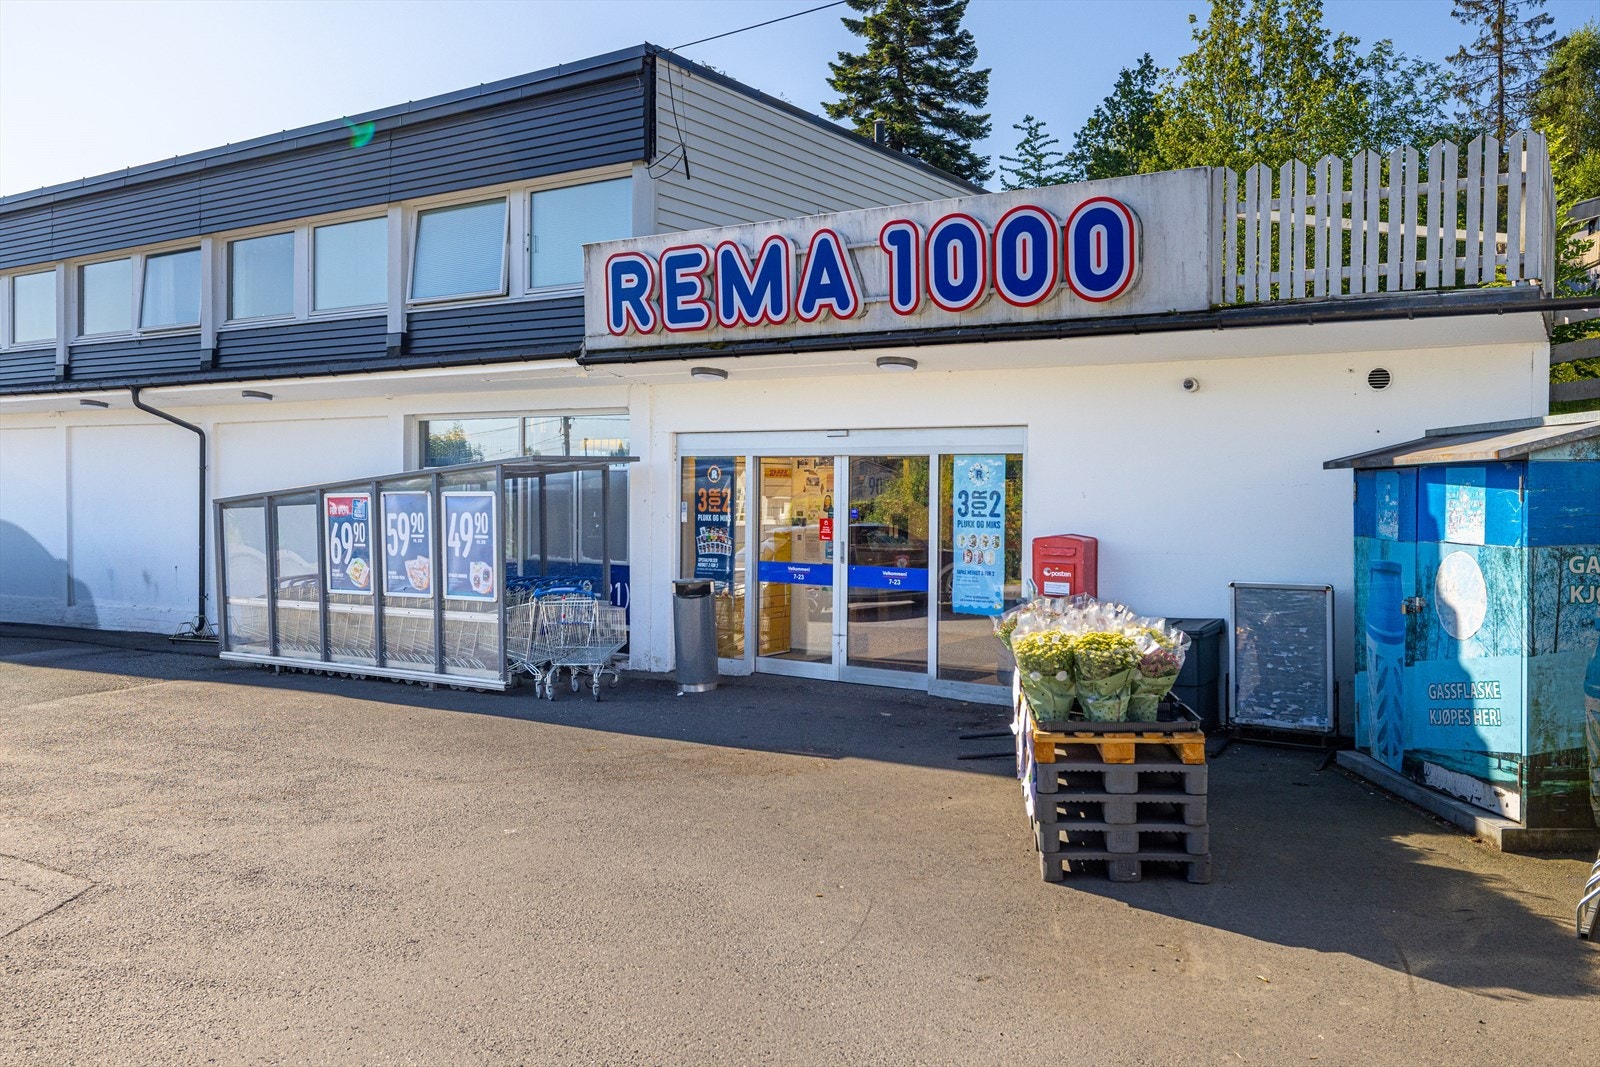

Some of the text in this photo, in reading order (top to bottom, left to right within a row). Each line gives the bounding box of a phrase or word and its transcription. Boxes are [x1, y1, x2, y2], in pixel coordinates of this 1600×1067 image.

[605, 196, 1136, 336] REMA 1000
[769, 469, 789, 477] DHL
[697, 487, 708, 512] 3
[708, 487, 721, 512] FOR
[721, 487, 731, 513] 2
[957, 489, 1001, 518] 3 FOR 2
[387, 512, 425, 557] 59 90
[447, 512, 489, 558] 49 90
[957, 519, 975, 528] PLUKK
[976, 520, 985, 529] OG
[330, 522, 366, 565] 69 90
[1428, 681, 1502, 700] GASSFLASKE
[1429, 707, 1502, 727] KJØPES HER!
